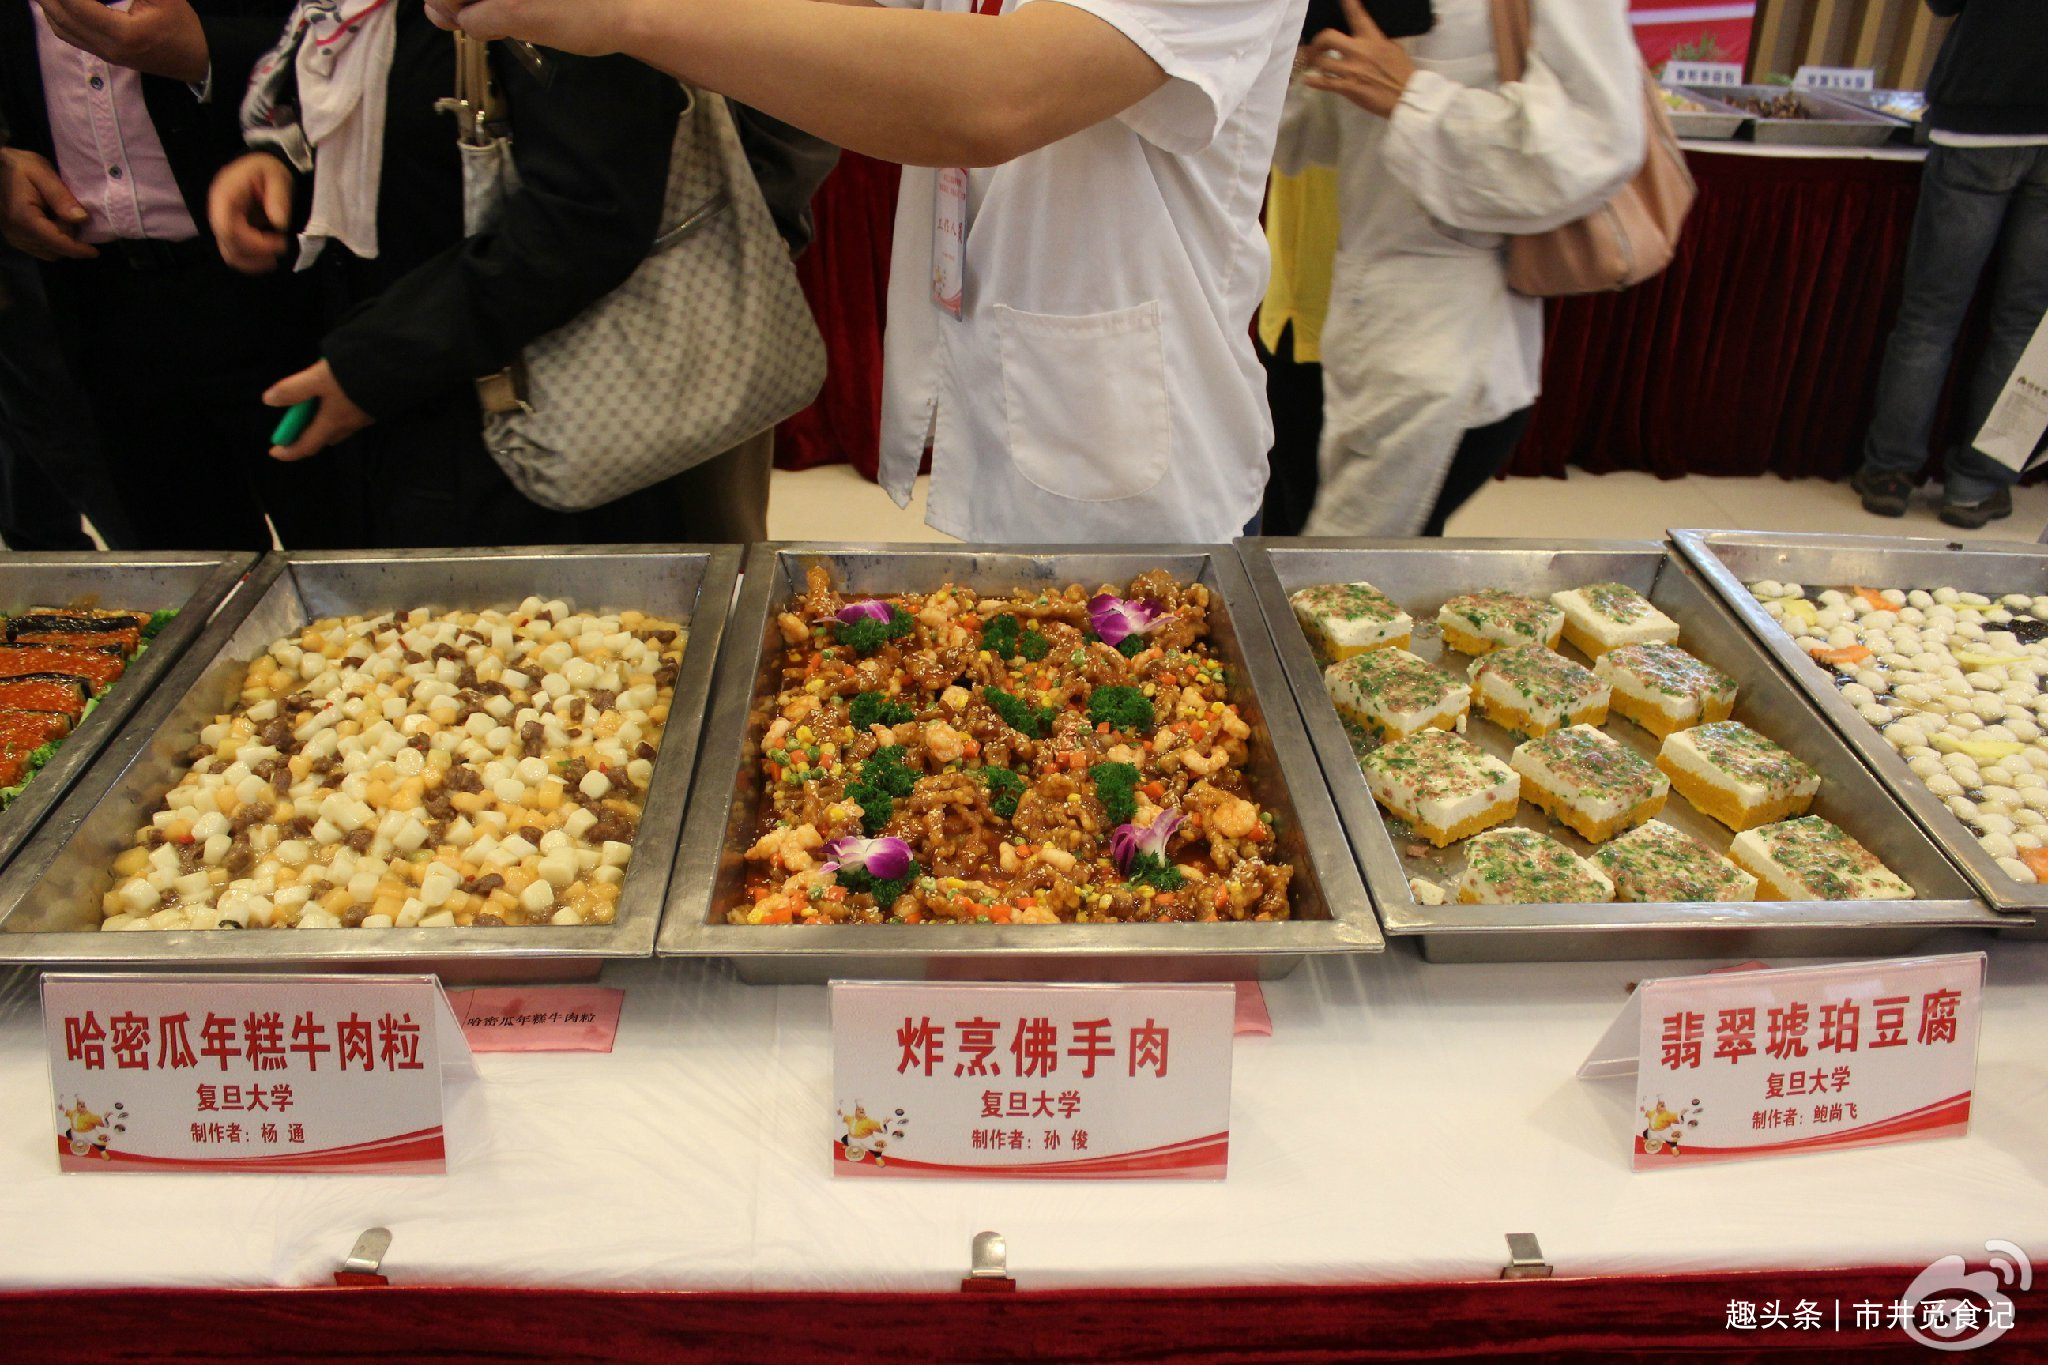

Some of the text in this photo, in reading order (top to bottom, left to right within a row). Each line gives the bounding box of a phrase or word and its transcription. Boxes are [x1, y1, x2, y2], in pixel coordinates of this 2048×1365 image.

[65, 1009, 425, 1072] 哈密瓜年糕牛肉粒
[897, 1015, 1169, 1078] 炸烹佛手肉
[1661, 988, 1962, 1070] 翡翠琥珀豆腐
[196, 1083, 294, 1112] 复旦大学
[981, 1090, 1081, 1119] 复旦大学
[1765, 1065, 1852, 1100] 复旦大学
